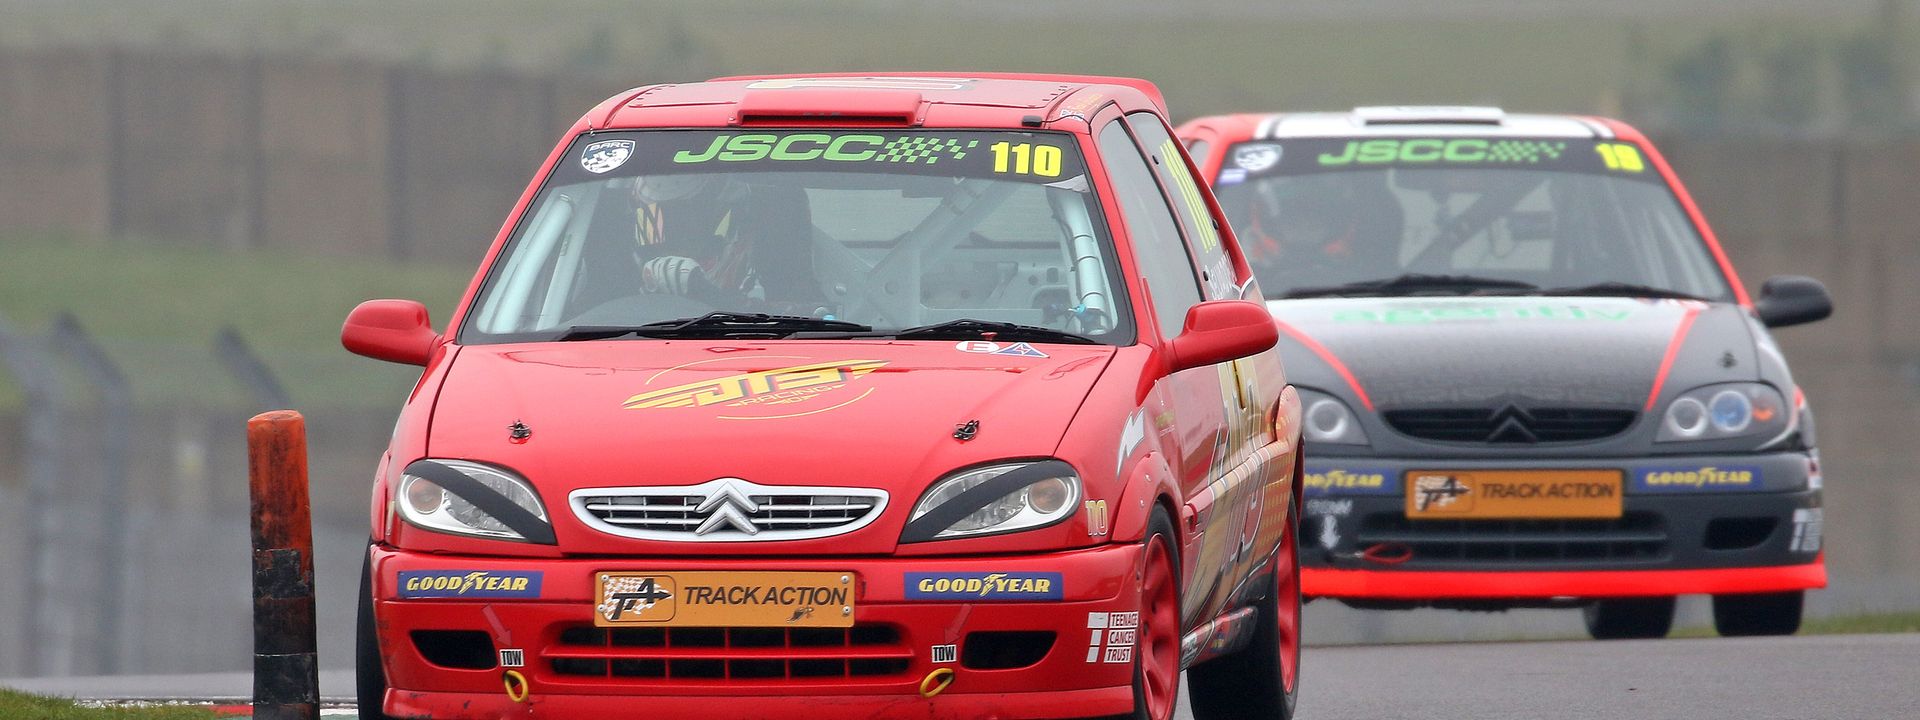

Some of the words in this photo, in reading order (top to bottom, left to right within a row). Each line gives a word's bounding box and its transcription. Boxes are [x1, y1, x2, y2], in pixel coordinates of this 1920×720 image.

[673, 134, 886, 164] JSCC
[1317, 139, 1490, 166] JSCC
[990, 141, 1063, 178] 110
[1645, 469, 1753, 487] GOODYEAR
[1482, 482, 1542, 498] TRACK
[1546, 482, 1616, 499] ACTION
[406, 573, 529, 593] GOODYEAR
[918, 574, 1051, 594] GOODYEAR
[684, 586, 761, 605] TRACK
[762, 586, 848, 606] ACTION
[1111, 613, 1138, 627] TEENAGE
[1109, 631, 1135, 644] CANCER
[501, 650, 522, 666] TOW
[932, 646, 955, 662] TOW
[1106, 647, 1131, 661] TRUST
